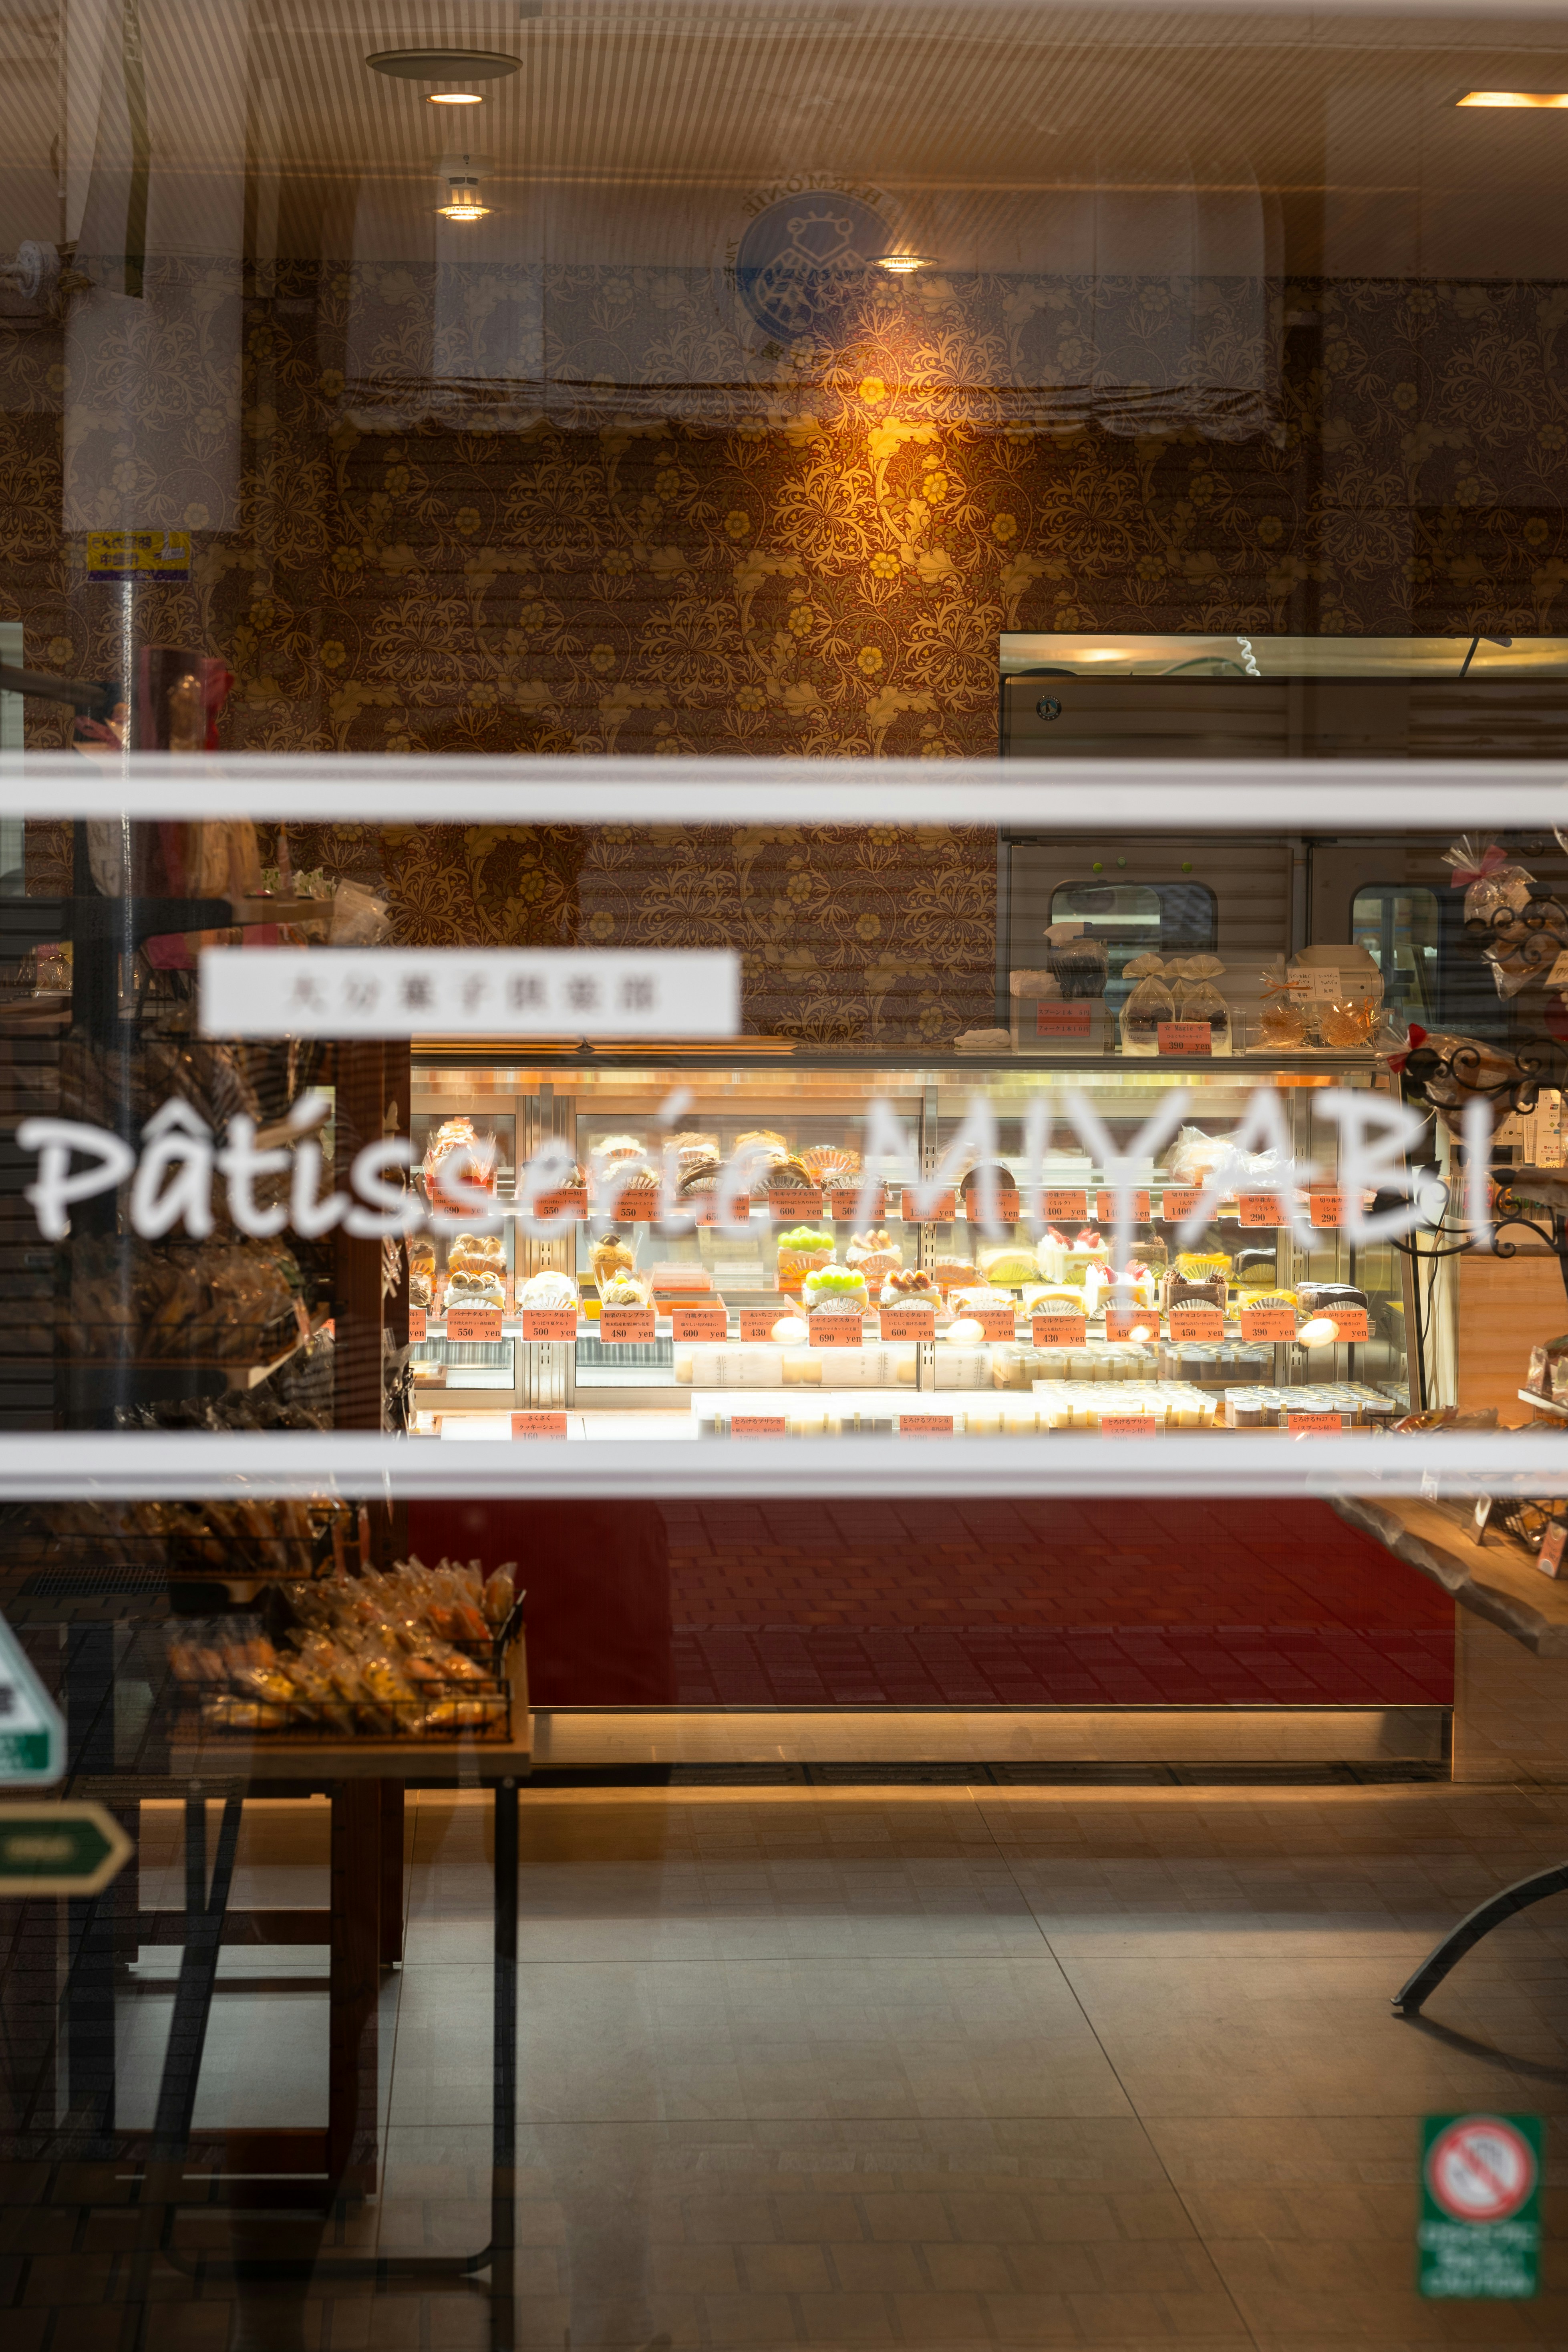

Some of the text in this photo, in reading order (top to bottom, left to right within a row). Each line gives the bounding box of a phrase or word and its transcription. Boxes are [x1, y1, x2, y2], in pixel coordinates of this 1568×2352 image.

[1169, 1041, 1183, 1049] 390
[863, 1086, 1492, 1322] MIYABI
[444, 1206, 459, 1214] 690
[621, 1208, 662, 1218] 550 yen
[842, 1207, 857, 1215] 500
[910, 1208, 954, 1217] 1200 yen
[1003, 1210, 1018, 1218] yen
[706, 1213, 721, 1221] 650
[1250, 1214, 1265, 1222] 290
[1321, 1214, 1337, 1222] 290
[457, 1328, 500, 1337] 550 yen
[533, 1328, 548, 1336] 500
[611, 1329, 626, 1337] 480
[751, 1329, 765, 1337] 430
[1252, 1328, 1267, 1336] 390
[819, 1334, 834, 1342] 690
[1043, 1334, 1058, 1343] 430
[523, 1432, 538, 1441] 160
